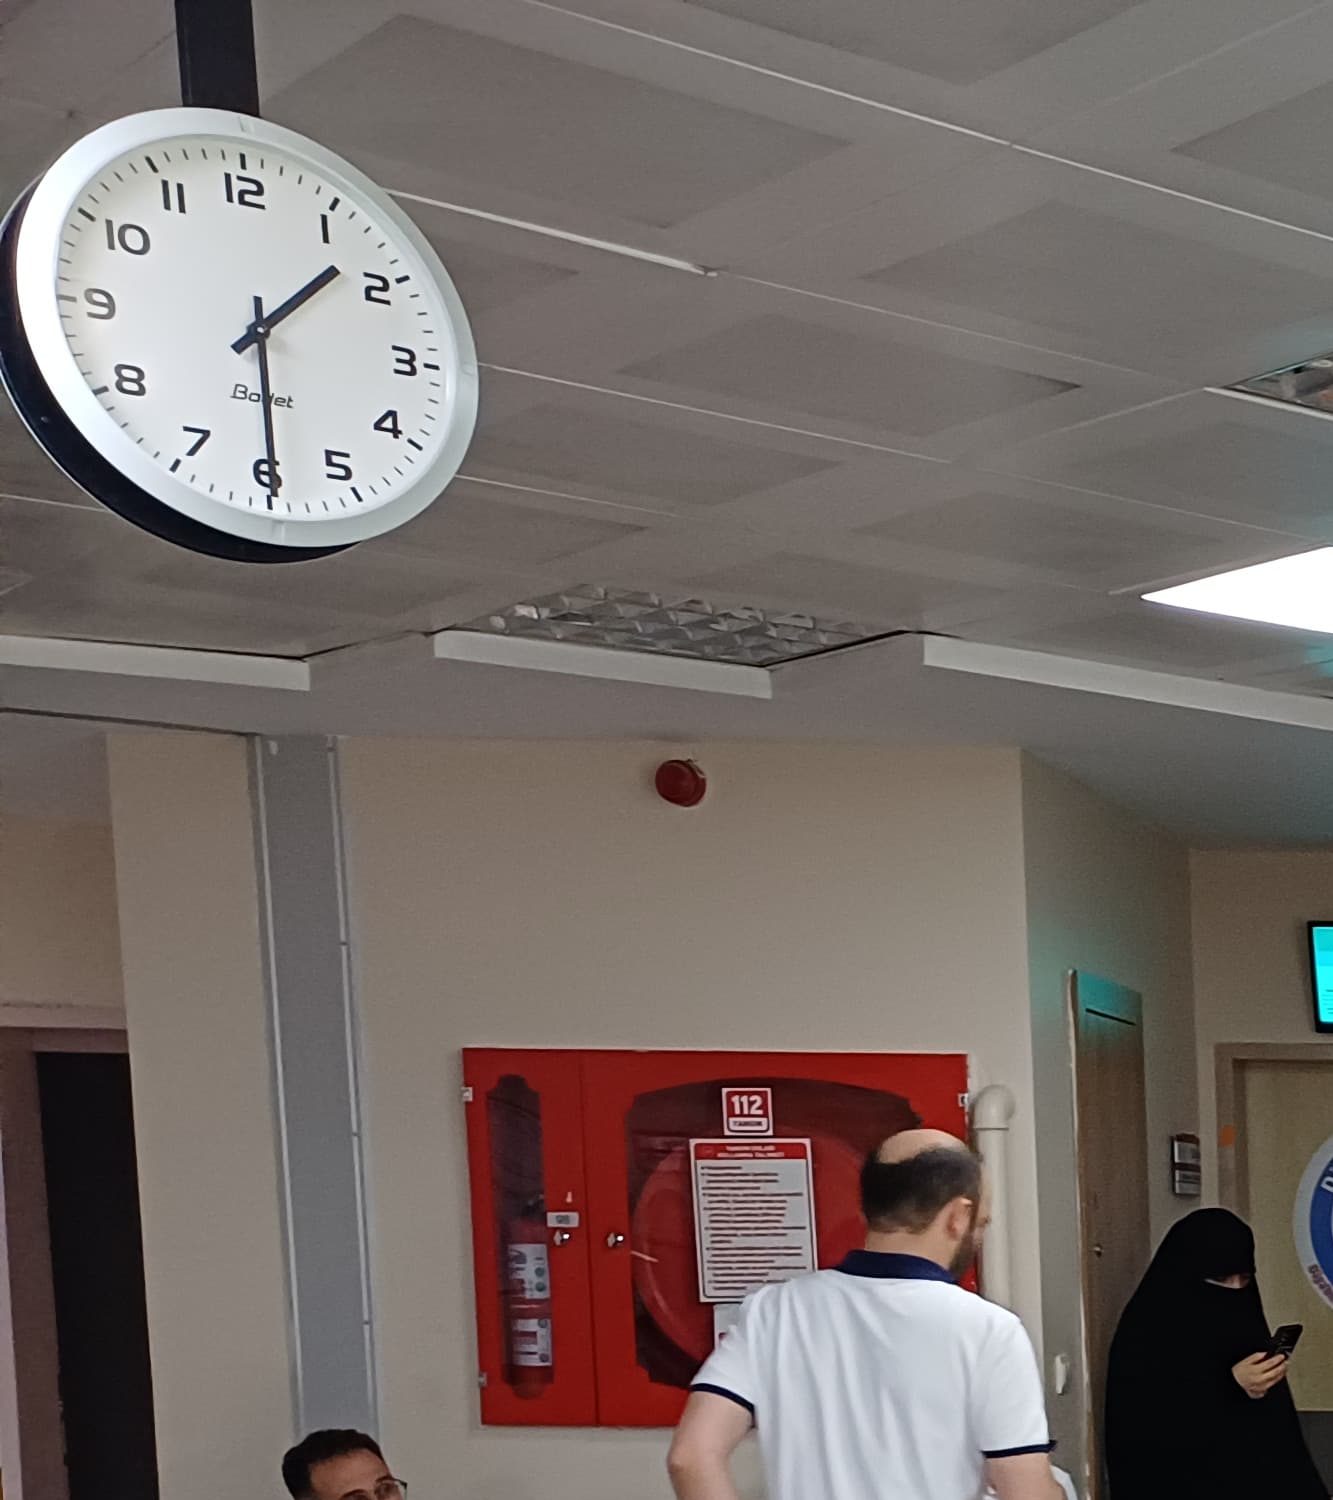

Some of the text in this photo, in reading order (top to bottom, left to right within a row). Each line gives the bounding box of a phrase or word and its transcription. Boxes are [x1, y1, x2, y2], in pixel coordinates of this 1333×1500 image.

[162, 180, 186, 213] 11
[225, 173, 265, 209] 12
[106, 219, 151, 255] 10
[320, 214, 330, 243] 1
[84, 287, 117, 320] 9
[362, 271, 391, 305] 2
[391, 344, 418, 376] 3
[113, 363, 147, 396] 8
[373, 410, 404, 439] 4
[182, 426, 211, 456] 7
[324, 449, 353, 481] 5
[731, 1095, 763, 1115] 112
